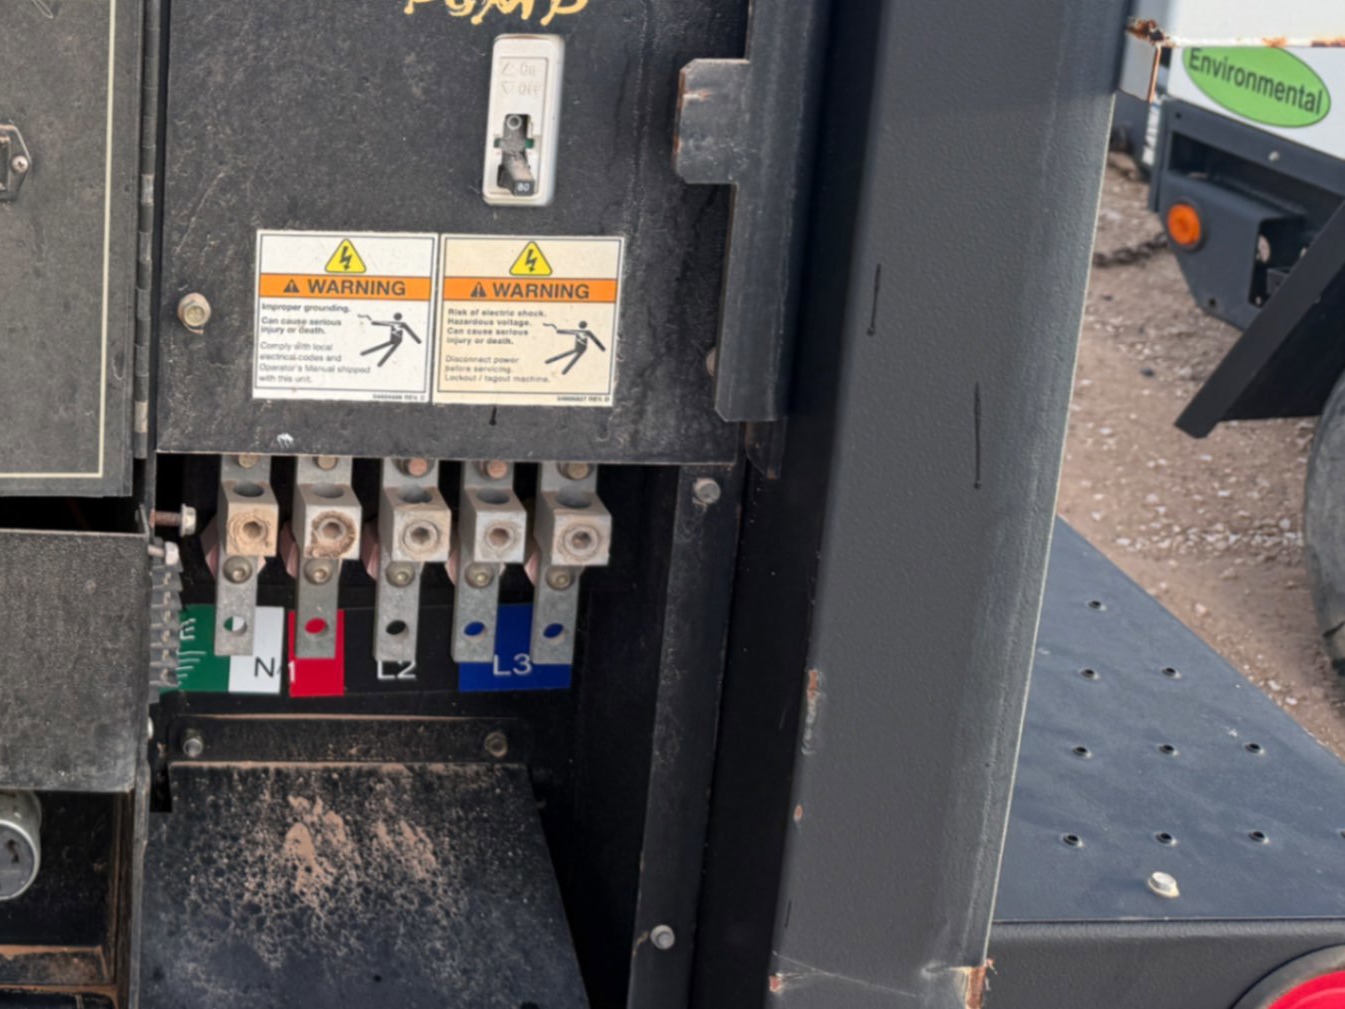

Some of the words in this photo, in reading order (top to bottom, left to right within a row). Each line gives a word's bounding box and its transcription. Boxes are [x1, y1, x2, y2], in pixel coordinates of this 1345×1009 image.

[1188, 47, 1323, 115] Environmental
[307, 278, 406, 295] WARNING
[493, 282, 589, 299] WARNING
[261, 303, 301, 311] Improper
[470, 308, 479, 316] of
[261, 316, 278, 324] Can
[254, 656, 276, 679] N
[377, 659, 416, 680] L2
[493, 654, 532, 676] L3
